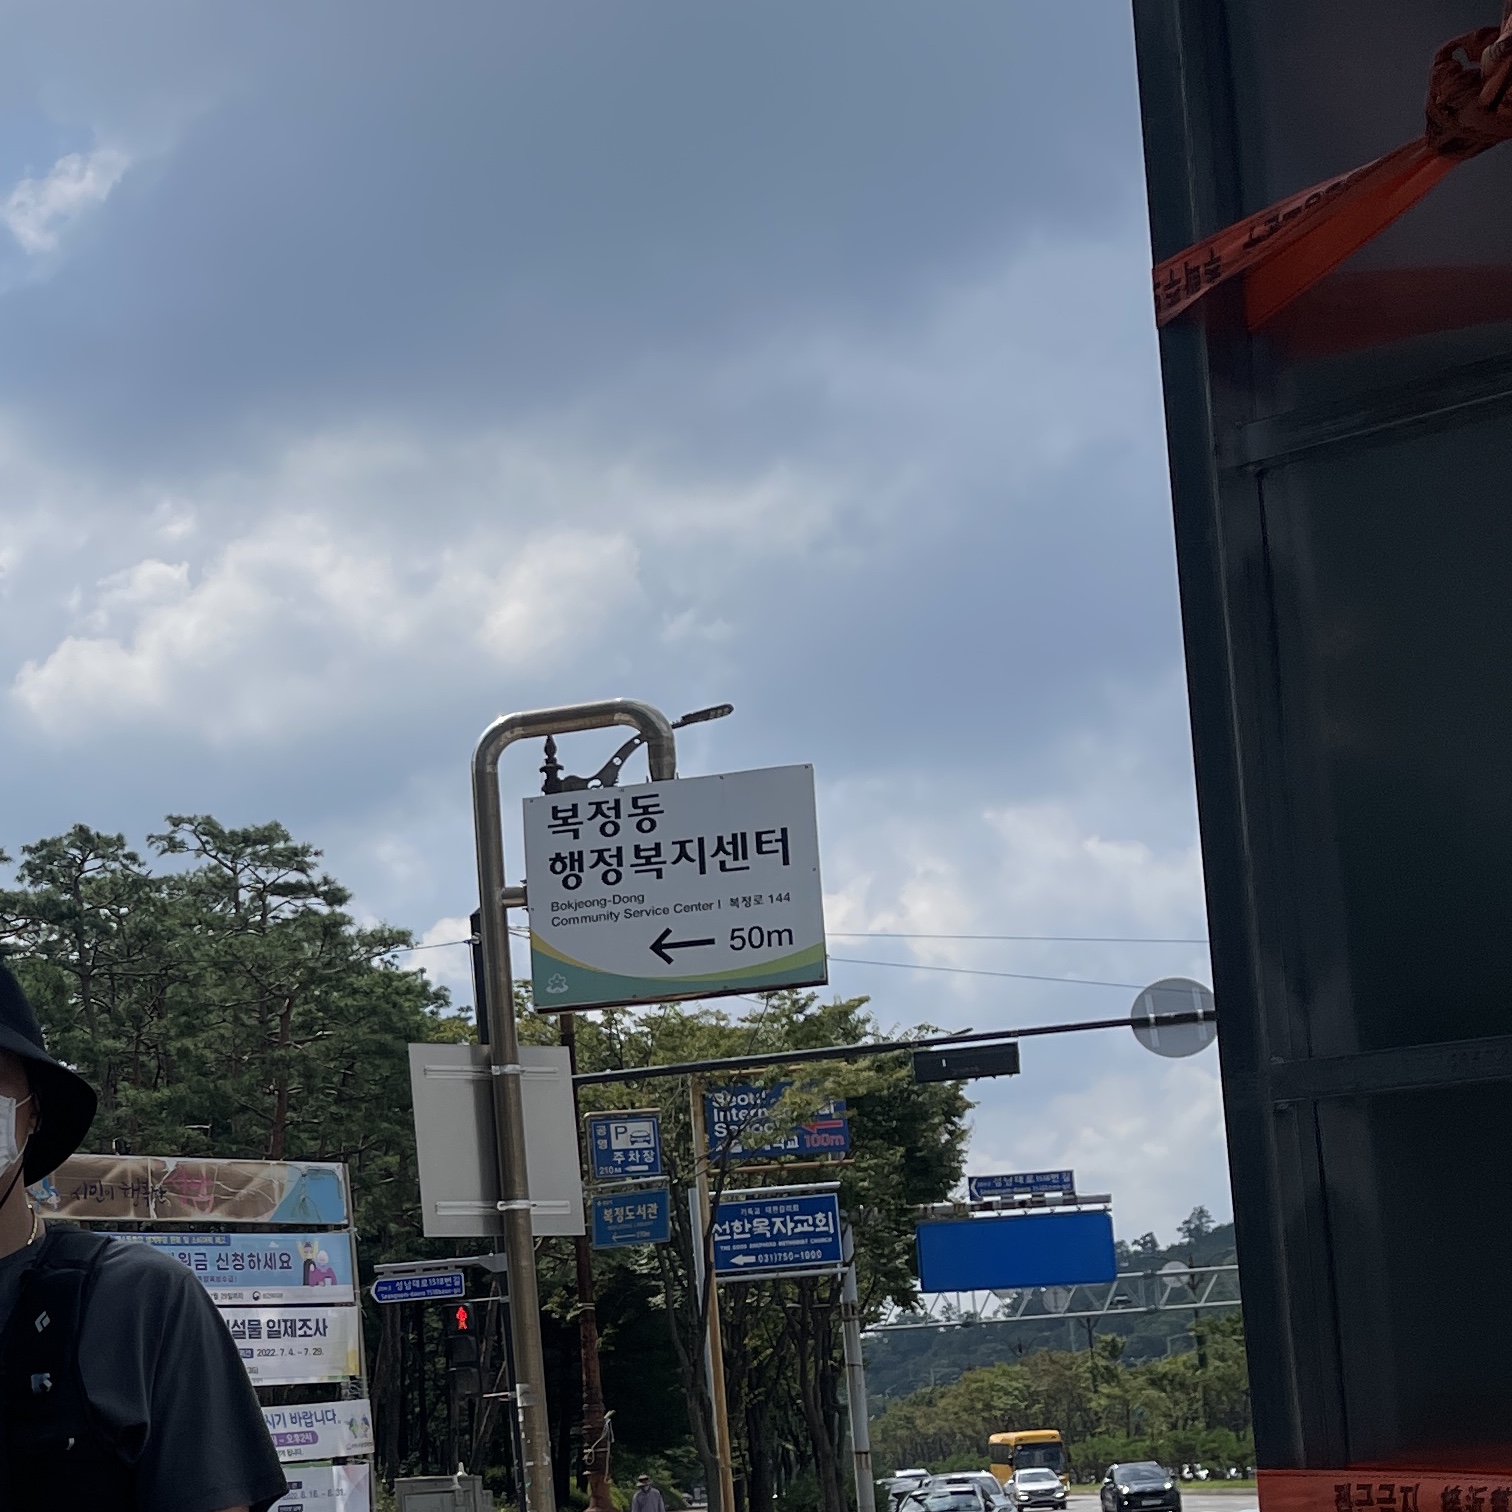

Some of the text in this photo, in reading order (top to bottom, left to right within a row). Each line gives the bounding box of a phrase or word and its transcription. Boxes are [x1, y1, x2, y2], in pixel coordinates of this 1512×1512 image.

[547, 793, 664, 840] 복정동
[548, 827, 791, 891] 행정복지센터
[551, 892, 645, 914] Bokjeong-Dong
[551, 892, 791, 927] Community Service Center 복정로 144
[729, 925, 794, 952] 50m
[614, 1125, 627, 1141] P
[804, 1133, 845, 1148] 100m
[613, 1149, 655, 1165] 주차장
[603, 1202, 659, 1224] 복정도서관
[711, 1211, 835, 1242] 선한목자교회
[172, 1252, 293, 1272] 원금 신청하세요
[226, 1318, 329, 1340] 설물 일제조사
[290, 1409, 342, 1429] 바랍니다.
[286, 1432, 314, 1444] 오후2시
